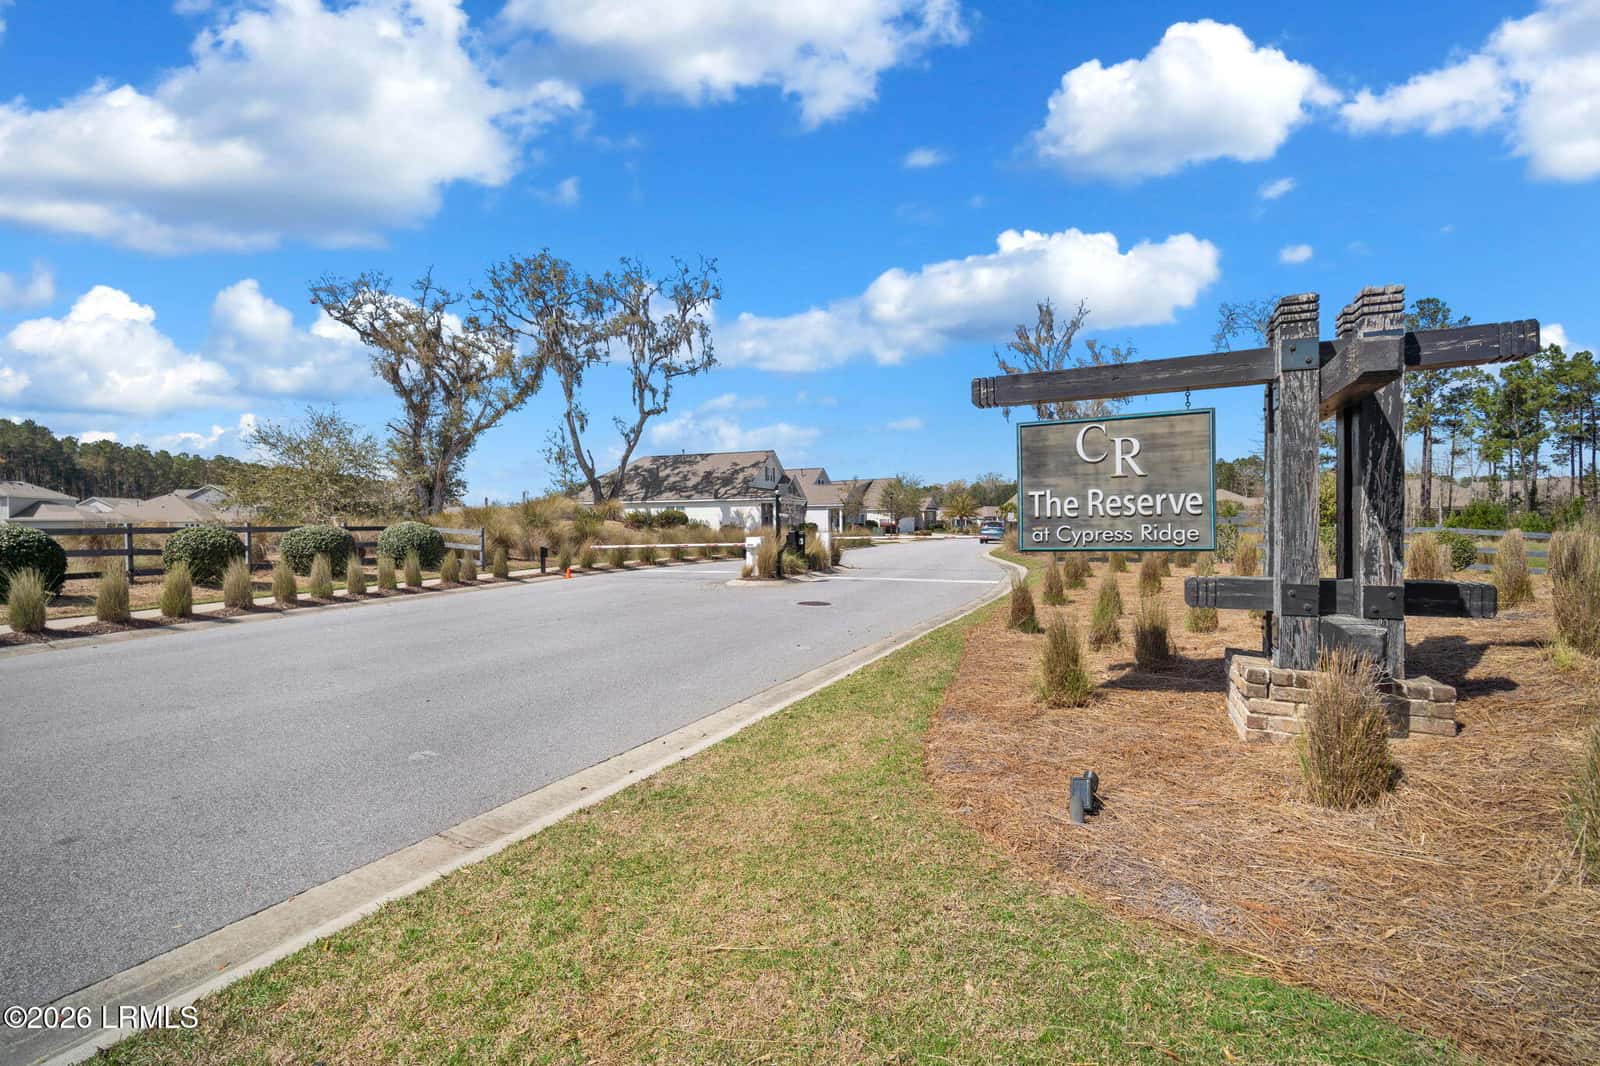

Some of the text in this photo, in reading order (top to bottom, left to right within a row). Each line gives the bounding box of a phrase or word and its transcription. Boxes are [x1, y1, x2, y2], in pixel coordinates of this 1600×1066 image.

[1028, 488, 1203, 518] The Reserve
[1032, 523, 1200, 547] at Cypress Ridge
